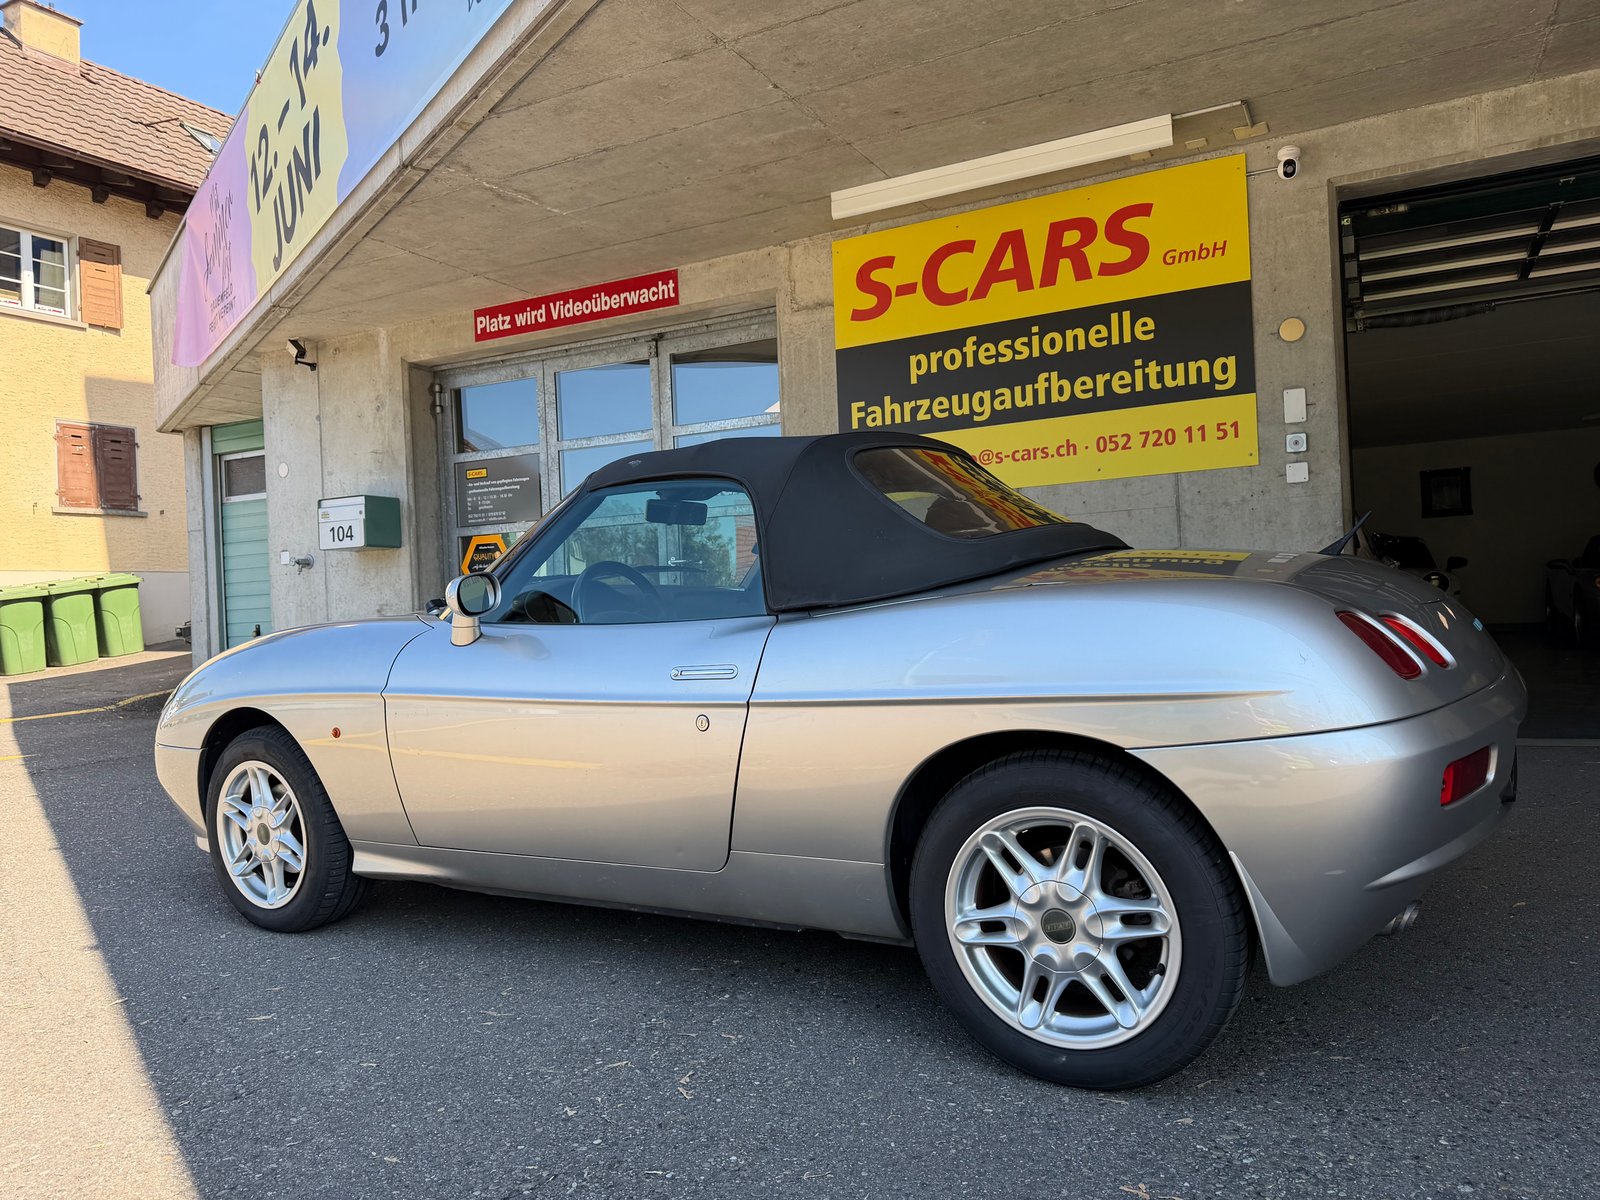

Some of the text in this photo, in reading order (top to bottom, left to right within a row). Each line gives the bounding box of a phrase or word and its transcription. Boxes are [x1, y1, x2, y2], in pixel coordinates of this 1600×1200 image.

[250, 123, 278, 214] 12.
[289, 0, 330, 112] 14.
[272, 105, 322, 273] JUNI
[850, 203, 1228, 321] S-CARS GmbH
[476, 280, 675, 334] Platz wird Videoüberwacht
[908, 311, 1156, 385] professionelle
[850, 354, 1238, 429] Fahrzeugaufbereitung
[1096, 433, 1132, 453] 052
[1139, 427, 1176, 448] 720
[1184, 424, 1207, 444] 11
[1216, 421, 1240, 441] 51
[329, 525, 354, 543] 104
